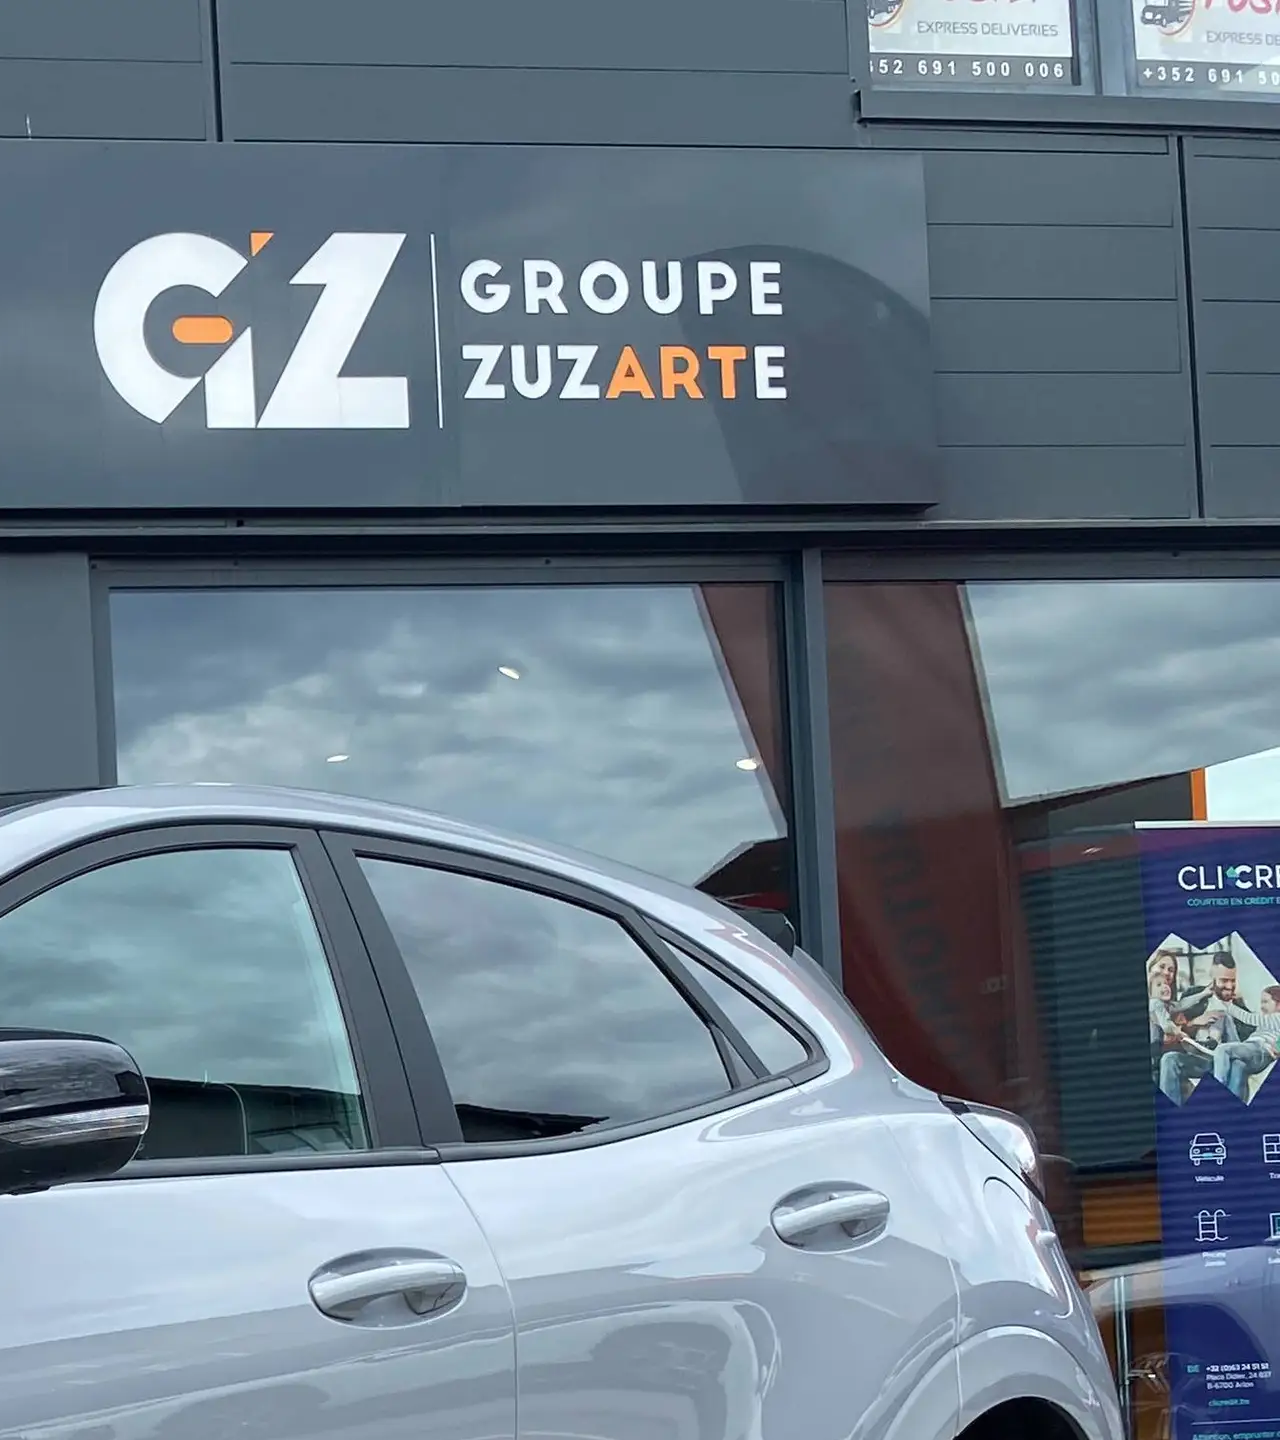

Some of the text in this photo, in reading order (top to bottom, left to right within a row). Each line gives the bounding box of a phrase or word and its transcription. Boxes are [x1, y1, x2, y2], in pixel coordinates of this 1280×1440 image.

[917, 20, 1059, 37] EXPRESS DELIVERIES
[1206, 30, 1263, 45] EXPRESS
[917, 60, 957, 76] 691
[972, 61, 1011, 77] 500
[1024, 62, 1064, 78] 006
[1143, 66, 1195, 83] +352
[1208, 68, 1243, 84] 691
[460, 259, 785, 316] GROUPE
[461, 343, 787, 399] ZUZARTE
